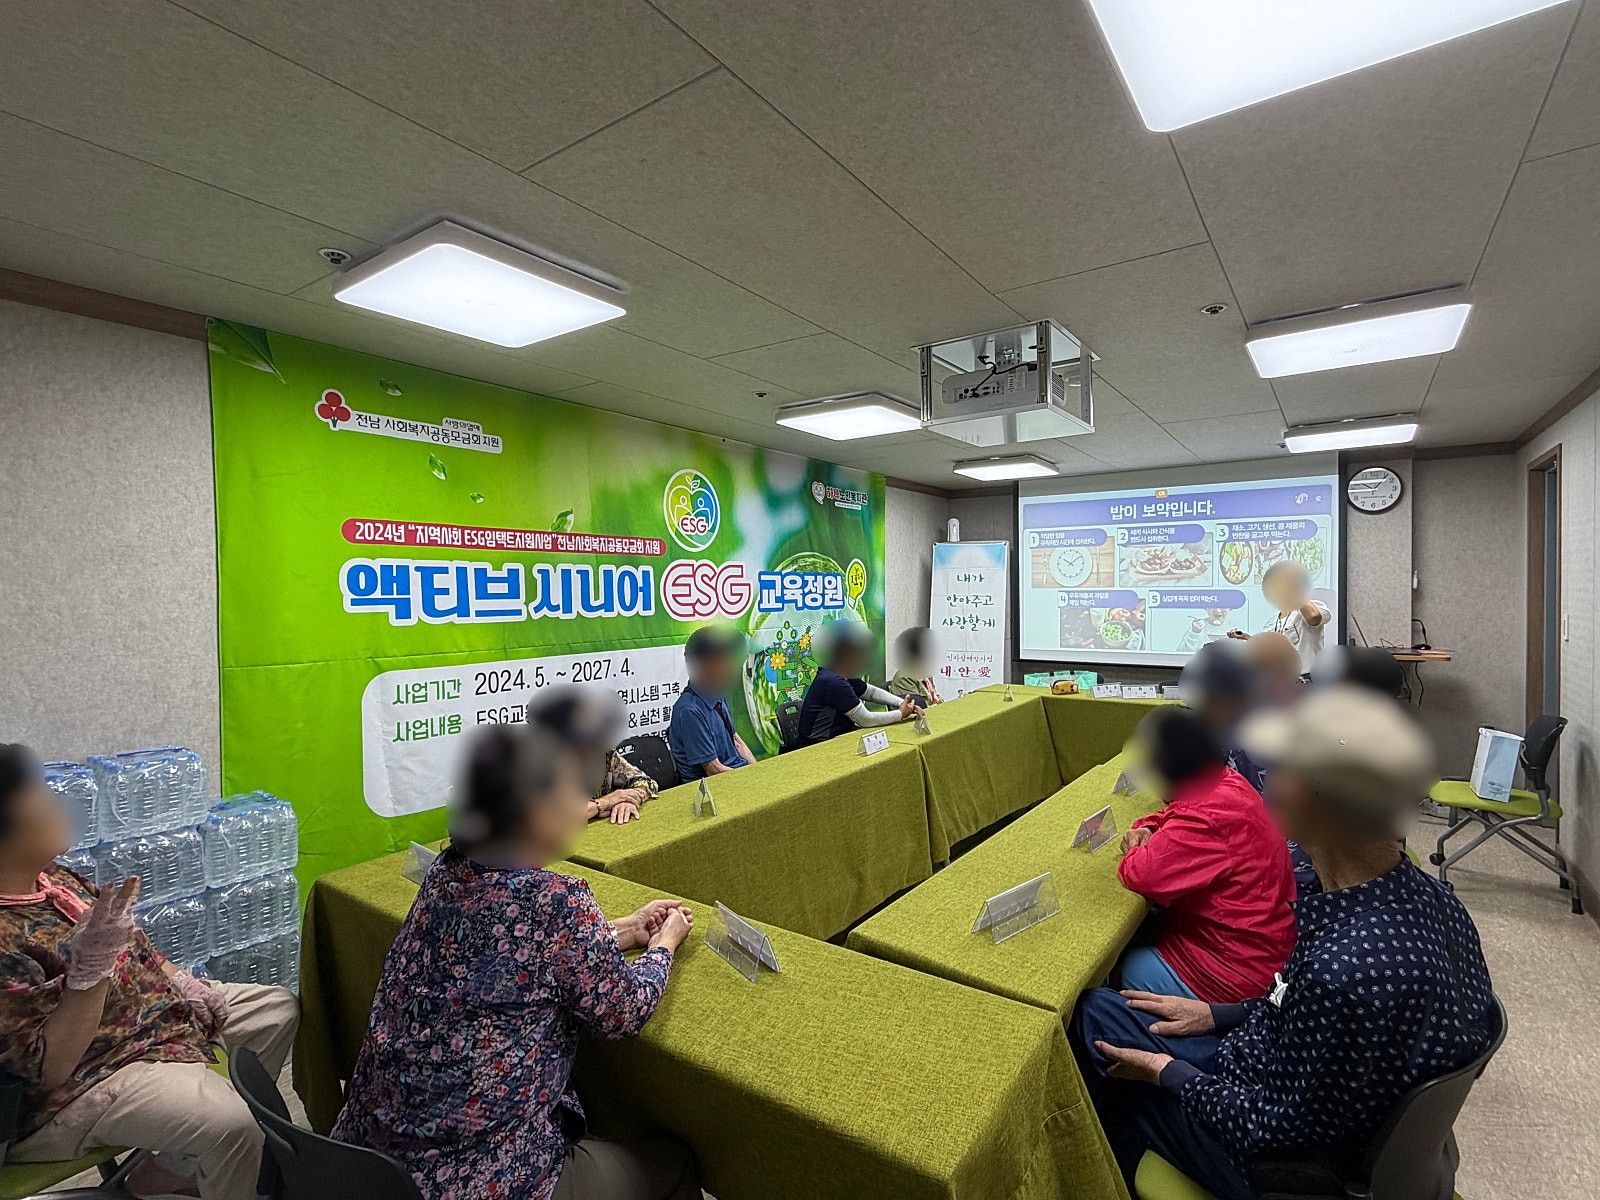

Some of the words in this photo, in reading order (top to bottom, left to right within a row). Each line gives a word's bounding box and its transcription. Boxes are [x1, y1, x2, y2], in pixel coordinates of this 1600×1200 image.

[355, 413, 381, 430] 전남
[384, 418, 481, 445] 사회복지공동모금회
[482, 435, 500, 448] 지원
[1110, 504, 1137, 520] 밥이
[1141, 499, 1216, 518] 보약입니다.
[680, 517, 707, 534] ESG
[355, 521, 405, 543] 2024년
[645, 540, 661, 555] 지원
[956, 573, 985, 583] 내가
[344, 562, 524, 621] 액티브
[532, 567, 652, 616] 시니어
[662, 562, 752, 618] ESG
[759, 573, 845, 609] 교육정원
[946, 594, 994, 608] 안아주고
[941, 613, 996, 632] 사랑할게
[392, 678, 462, 706] 사업기간
[661, 682, 680, 698] 구축
[392, 713, 462, 743] 사업내용
[476, 704, 530, 725] ESG교
[628, 712, 638, 729] &
[640, 707, 660, 727] 실천
